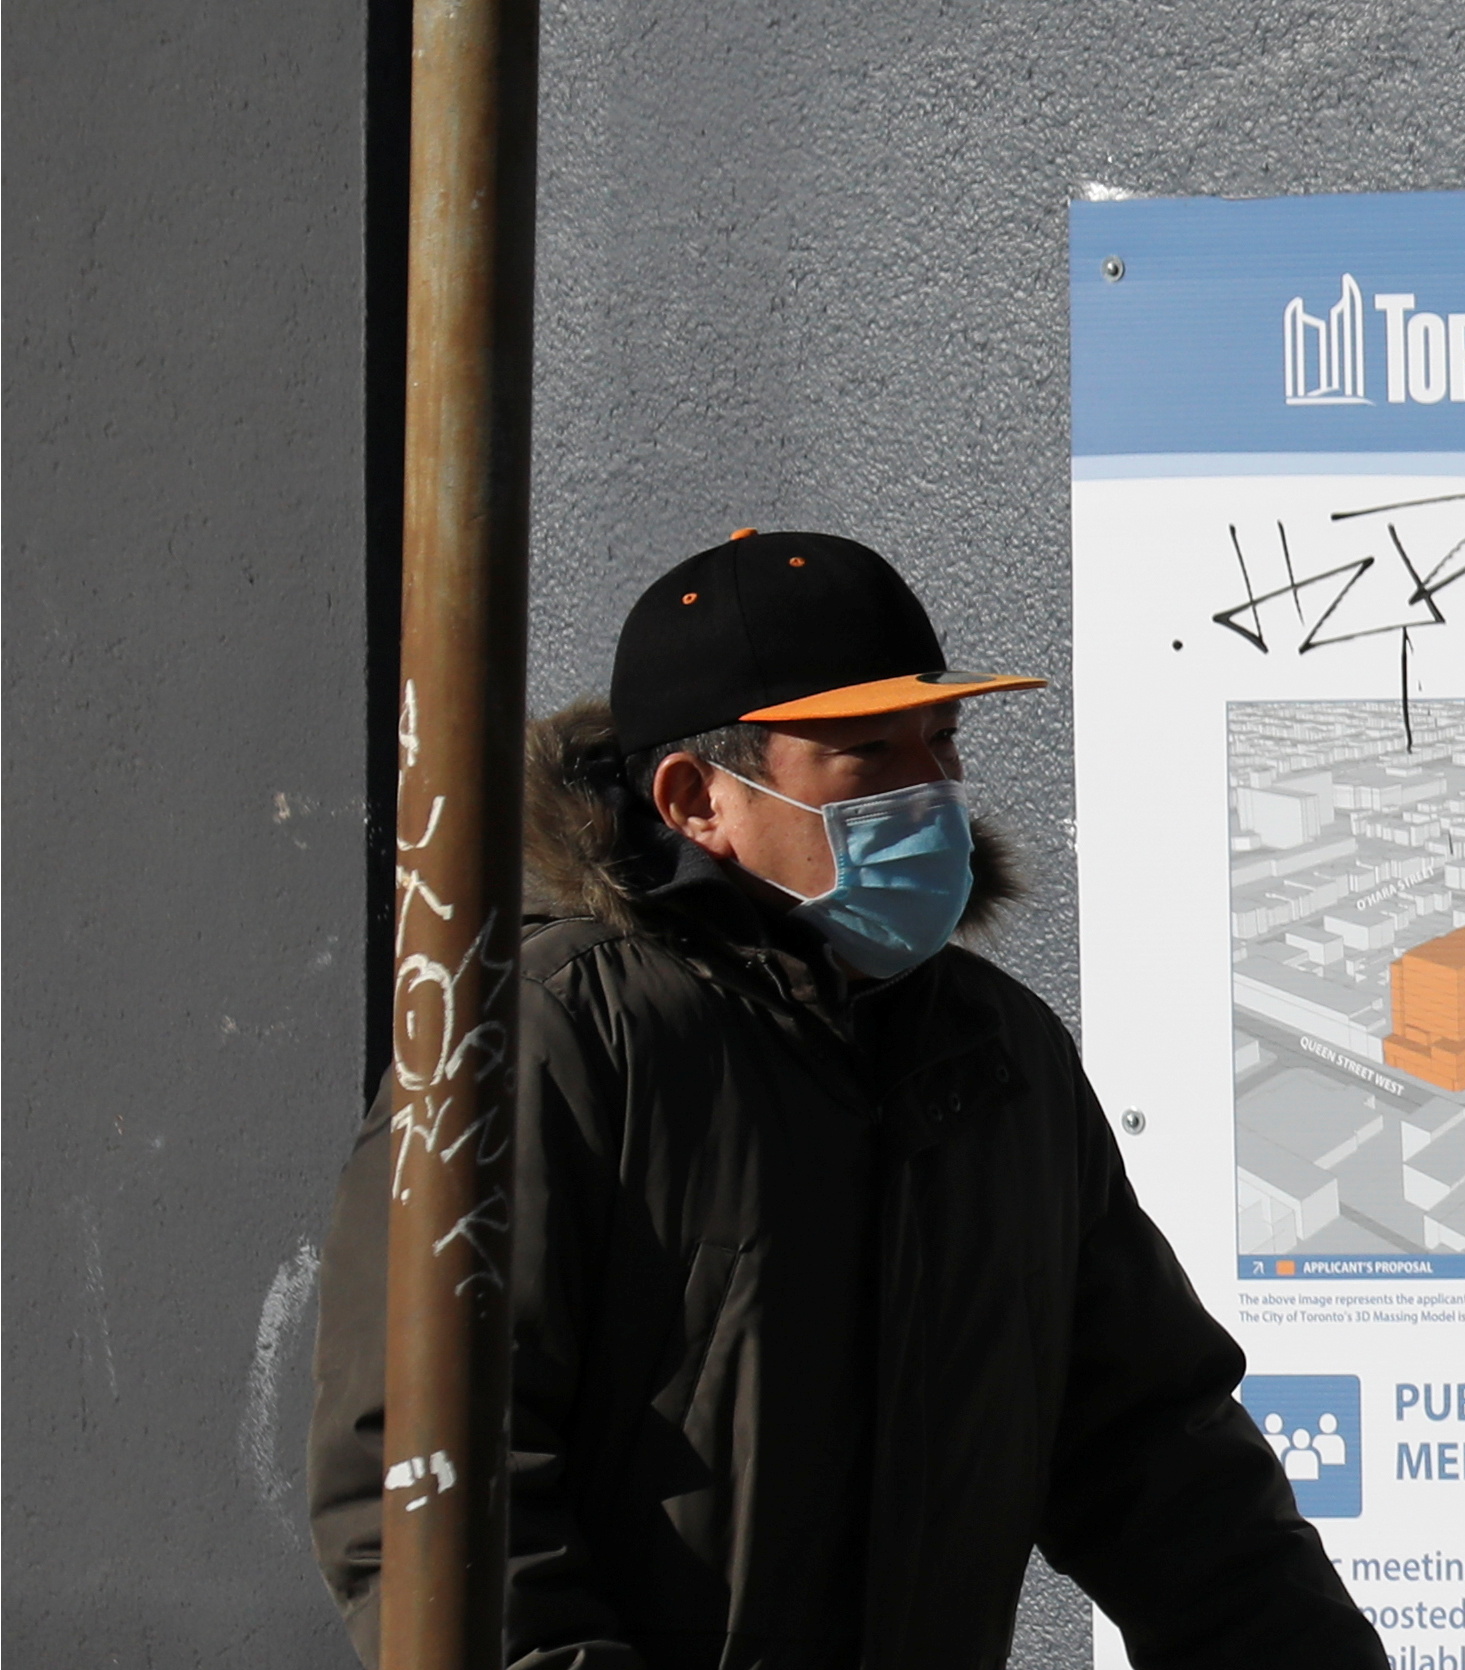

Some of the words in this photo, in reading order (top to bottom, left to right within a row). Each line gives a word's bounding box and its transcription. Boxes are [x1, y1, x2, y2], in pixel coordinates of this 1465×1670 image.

[1299, 1035, 1336, 1063] QUEEN
[1336, 1054, 1375, 1082] STREET
[1375, 1072, 1405, 1097] WEST
[1303, 1260, 1373, 1274] APPLICANT'S
[1375, 1260, 1433, 1274] PROPOSAL
[1238, 1293, 1260, 1306] The
[1262, 1293, 1296, 1306] above
[1298, 1293, 1332, 1307] image
[1335, 1294, 1394, 1308] represents
[1395, 1293, 1415, 1306] the
[1239, 1310, 1260, 1323] The
[1262, 1310, 1283, 1326] City
[1286, 1310, 1298, 1323] of
[1300, 1310, 1353, 1323] Toronto's
[1355, 1310, 1371, 1323] 3D
[1373, 1310, 1419, 1326] Massing
[1421, 1310, 1456, 1323] Model
[1458, 1310, 1465, 1323] is
